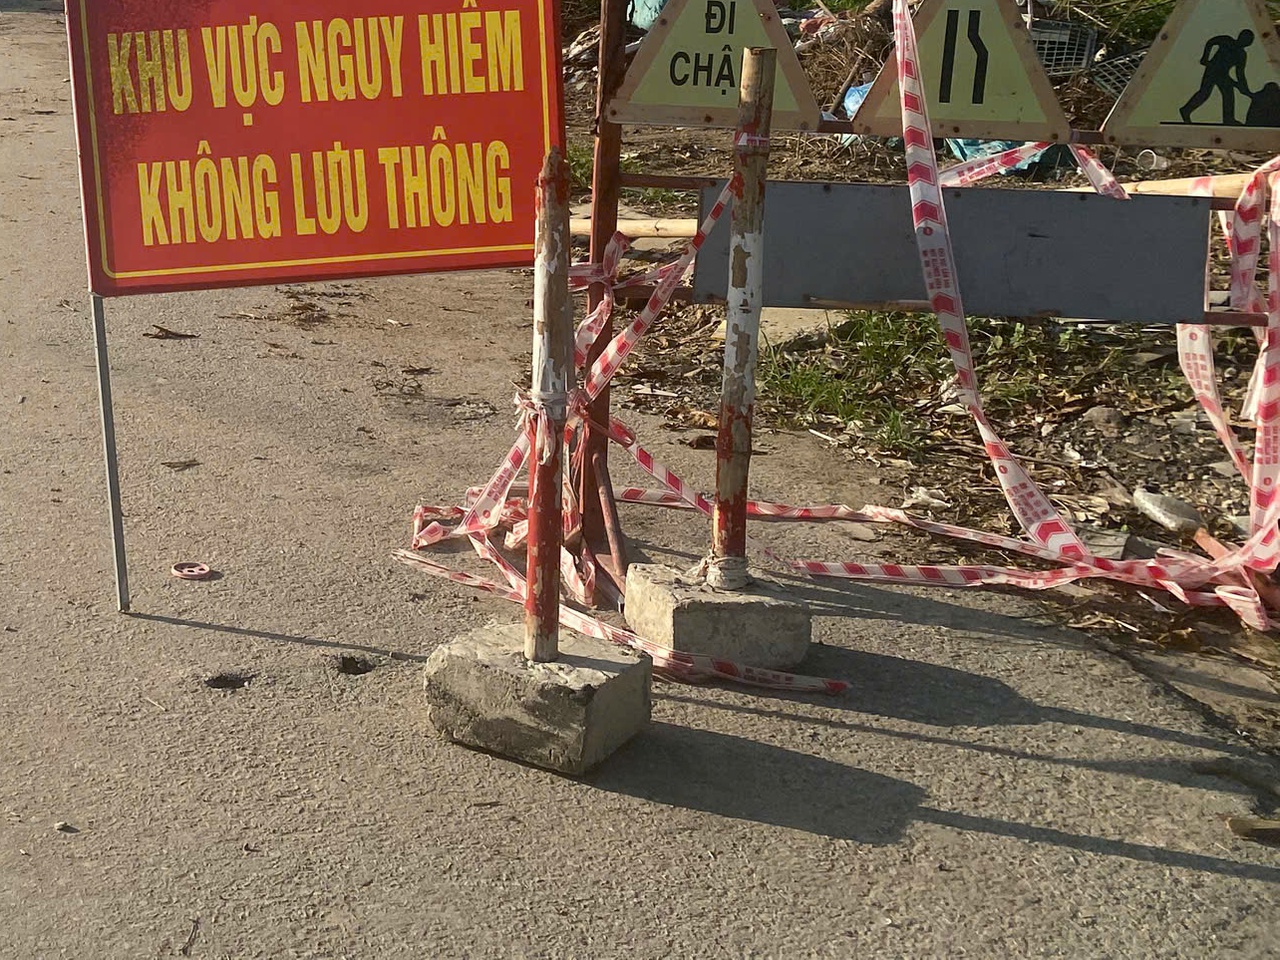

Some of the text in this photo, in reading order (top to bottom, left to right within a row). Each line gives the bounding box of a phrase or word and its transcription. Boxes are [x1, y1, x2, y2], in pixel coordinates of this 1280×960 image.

[705, 0, 736, 34] ĐI
[108, 29, 192, 114] KHU
[201, 15, 284, 126] VỰC
[295, 16, 404, 102] NGUY
[670, 44, 744, 96] CHẬ
[137, 126, 512, 246] KHÔNG LƯU THÔNG
